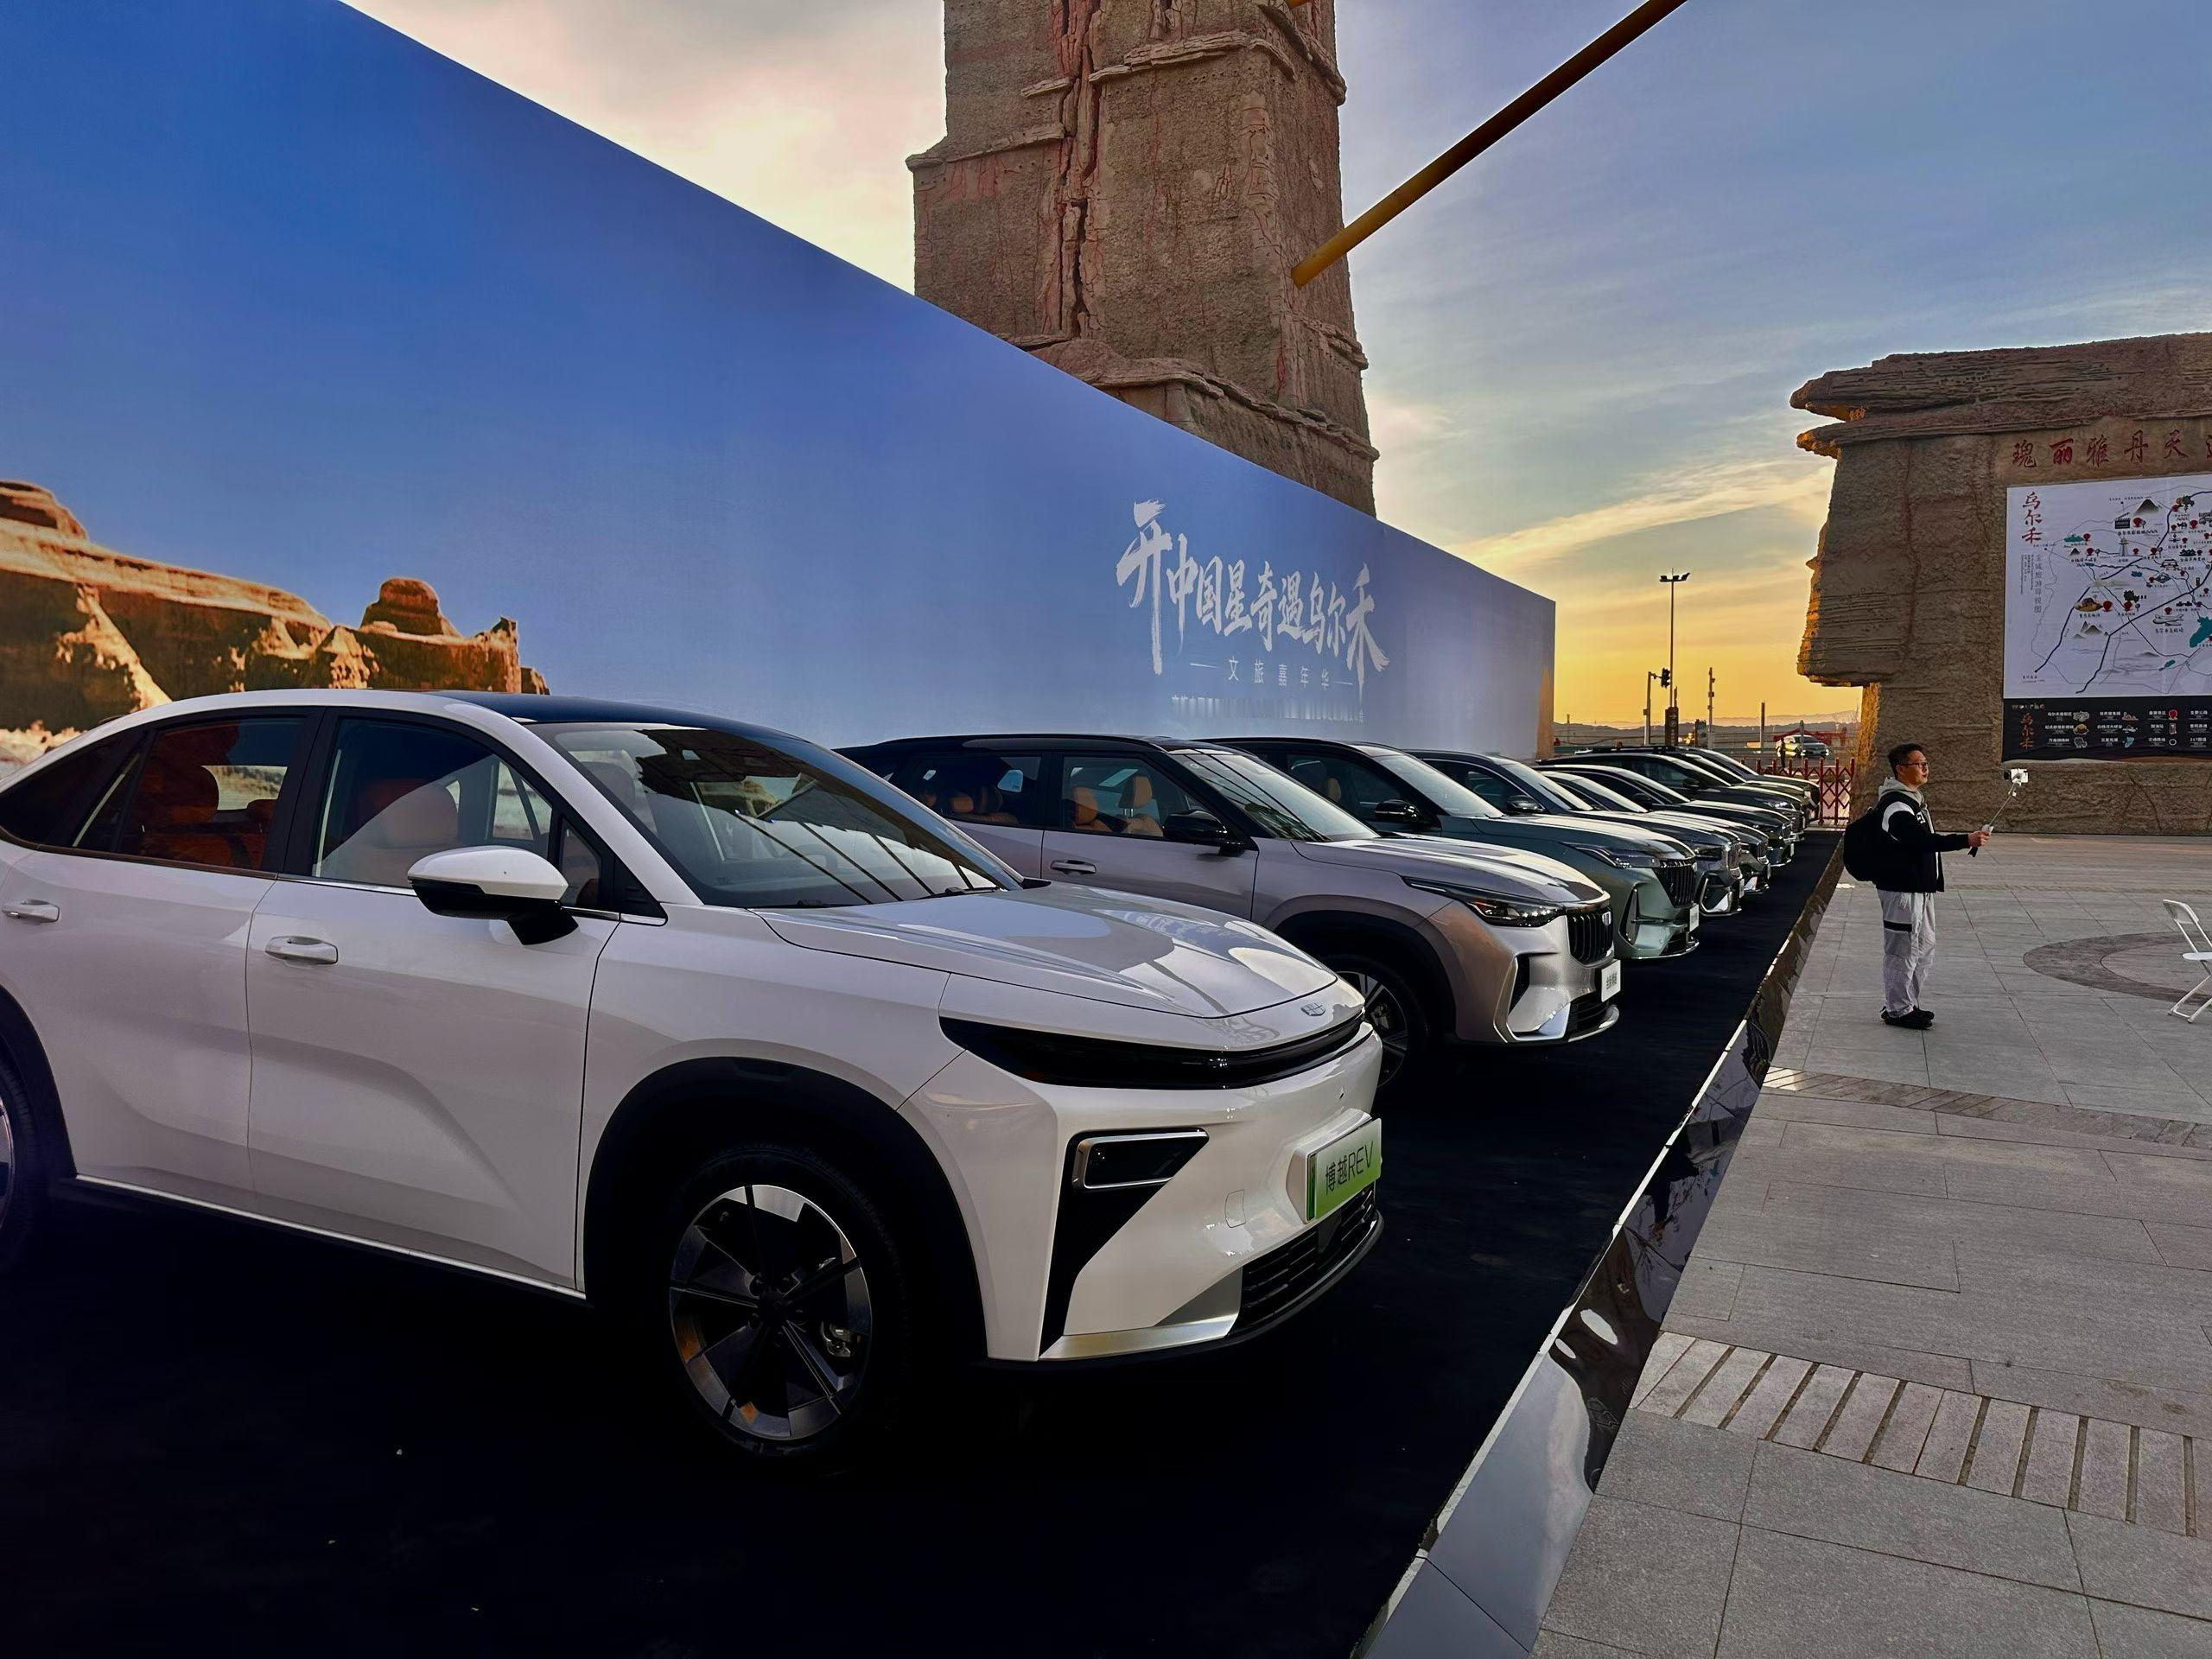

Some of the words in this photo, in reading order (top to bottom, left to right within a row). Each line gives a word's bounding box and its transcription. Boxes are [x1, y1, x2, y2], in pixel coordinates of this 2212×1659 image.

[2022, 492, 2043, 544] 乌尔禾
[1228, 656, 1330, 690] 文旅嘉年华
[1325, 1141, 1374, 1195] 博越REV
